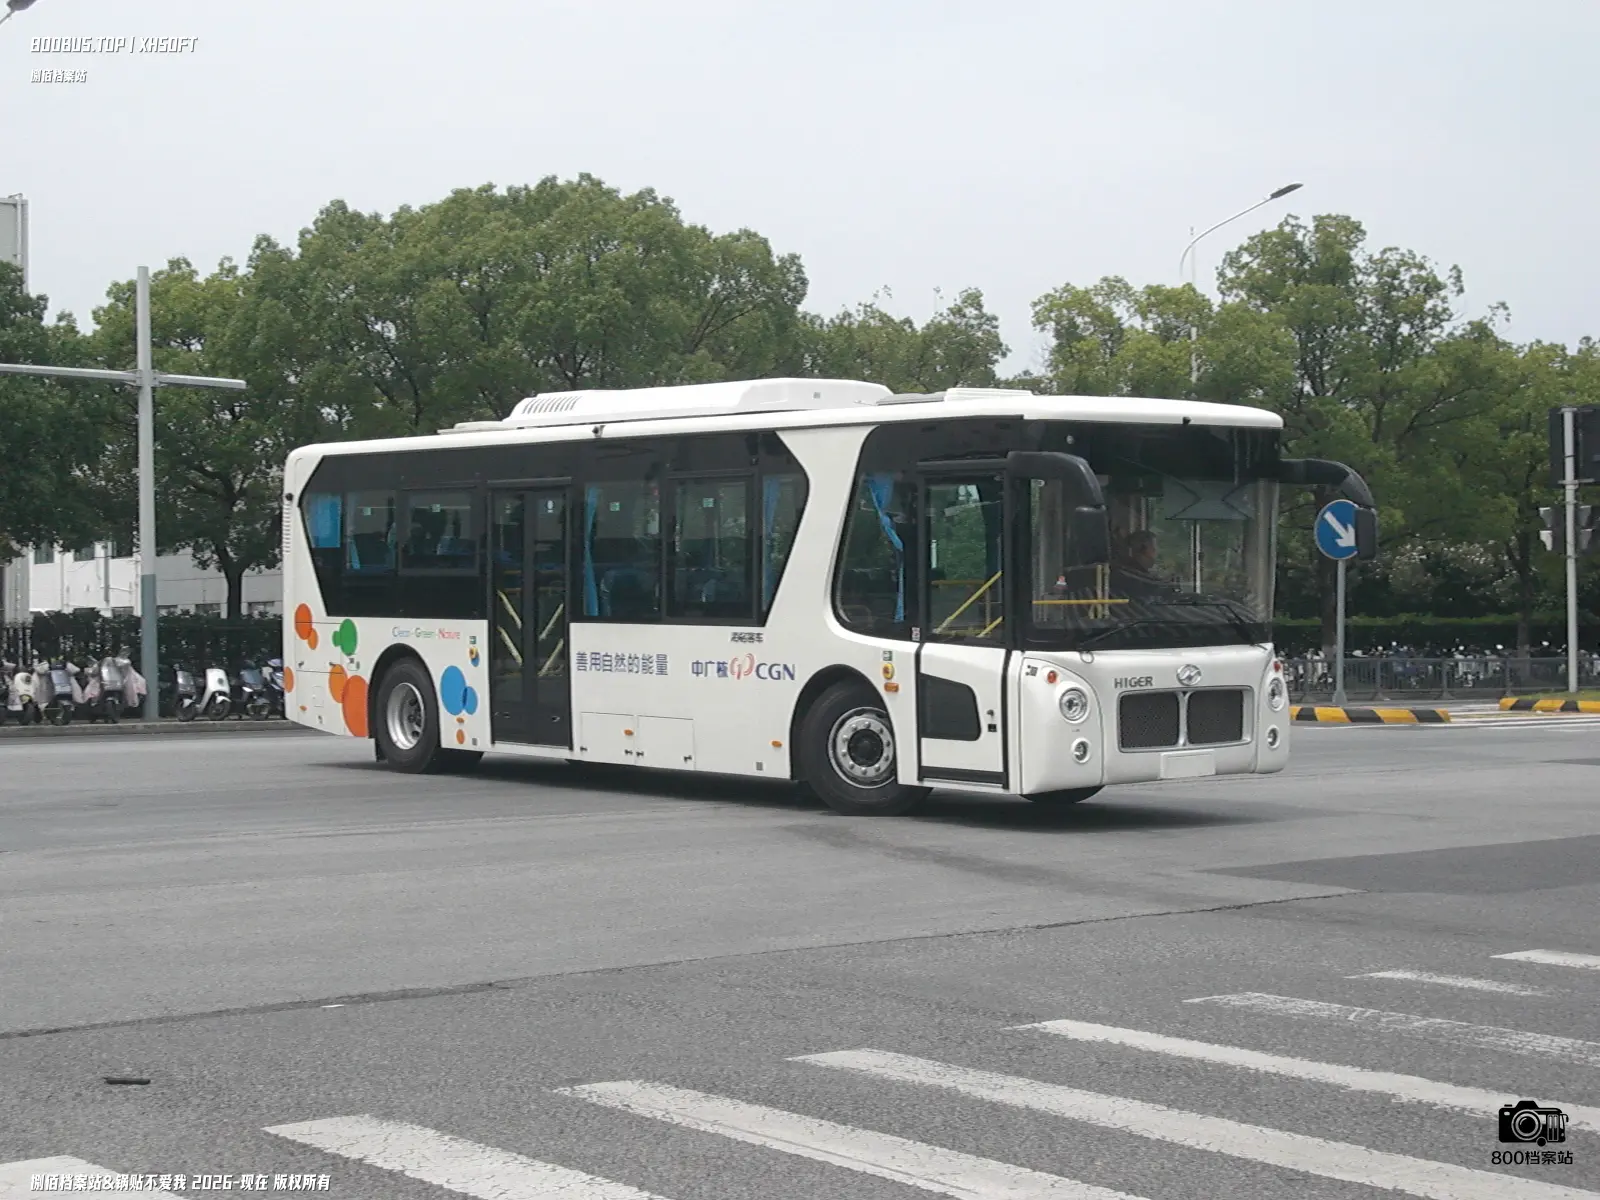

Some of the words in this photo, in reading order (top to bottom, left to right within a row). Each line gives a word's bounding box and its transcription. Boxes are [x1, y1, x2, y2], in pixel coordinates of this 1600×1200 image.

[576, 651, 668, 676] 善用自然的能量
[691, 660, 729, 678] 中广核
[756, 662, 796, 681] CGN
[1114, 676, 1153, 689] HIGER
